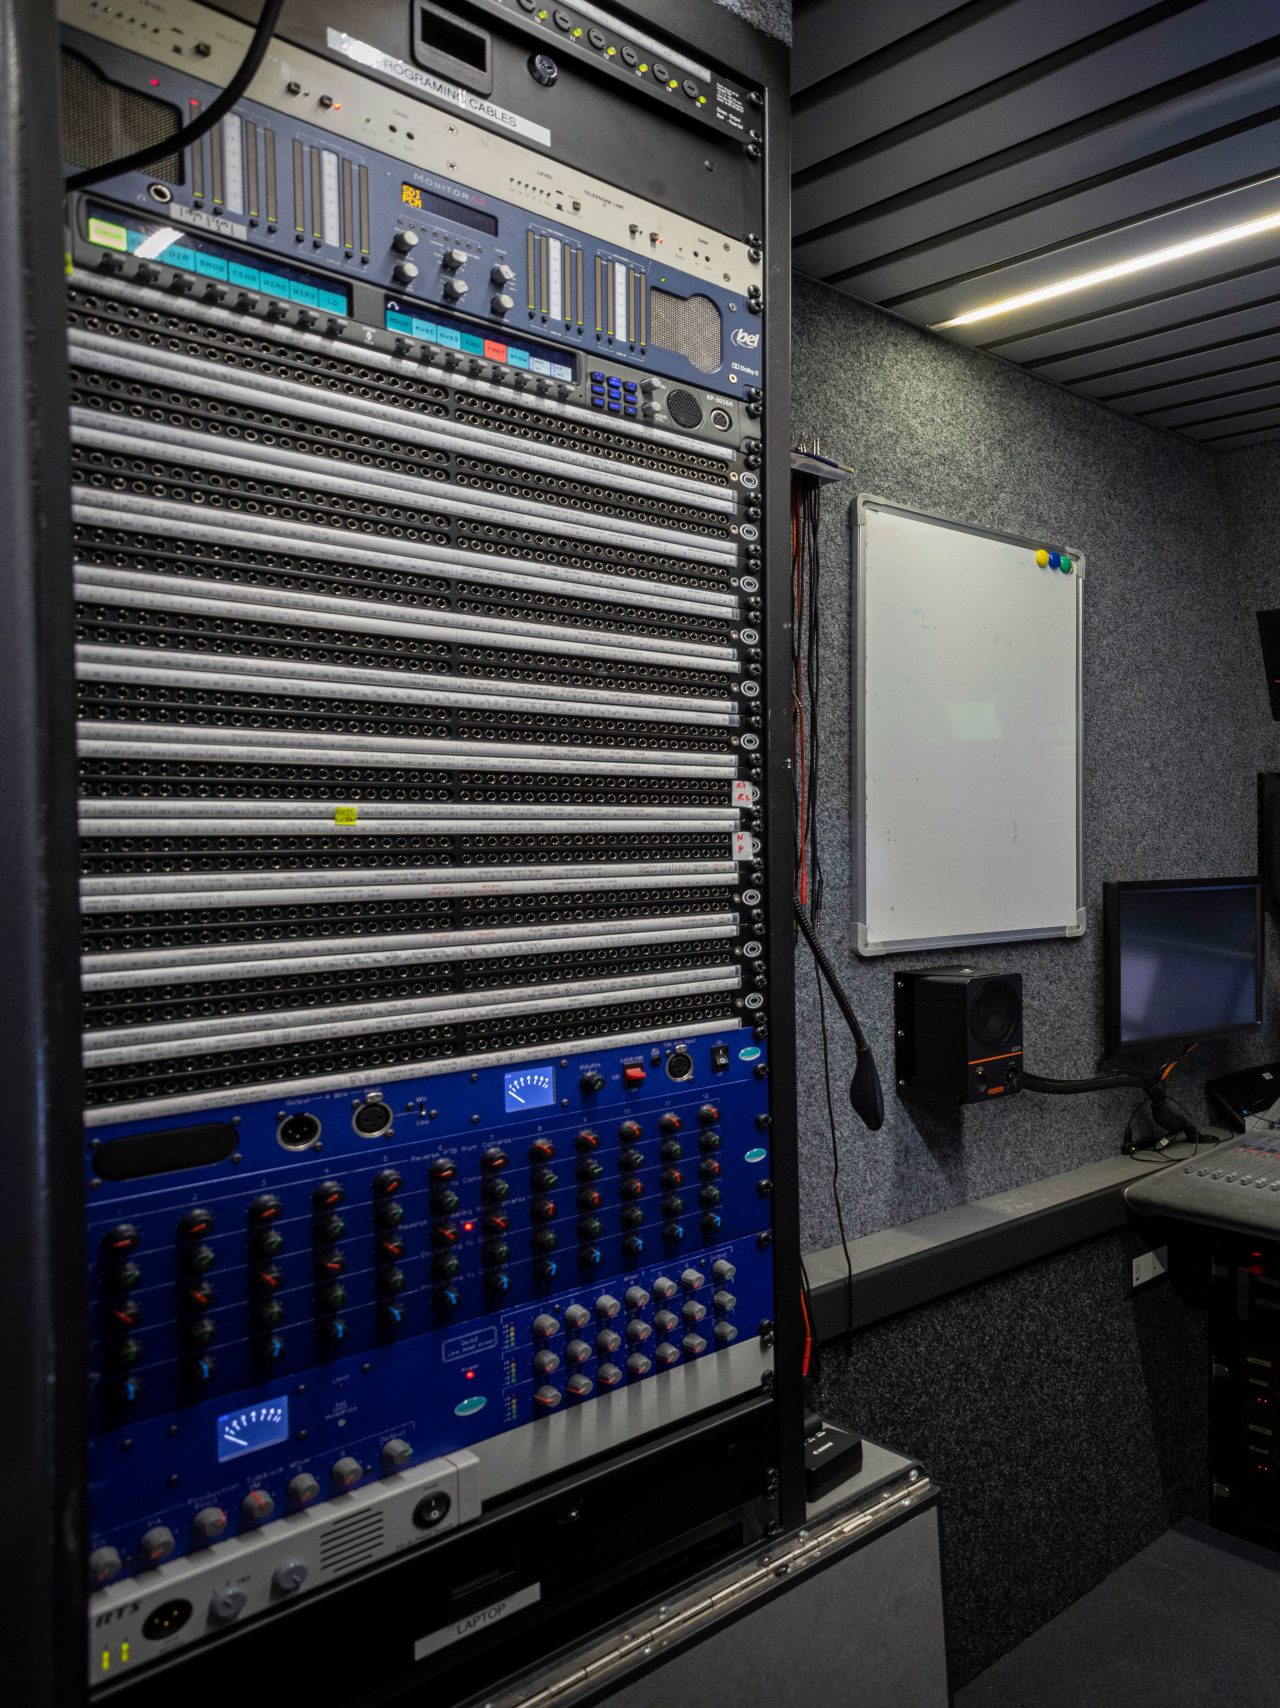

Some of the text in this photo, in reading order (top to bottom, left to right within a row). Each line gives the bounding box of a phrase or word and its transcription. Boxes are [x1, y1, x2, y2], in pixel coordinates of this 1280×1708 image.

[469, 98, 517, 128] CABLES
[413, 172, 469, 199] MONITOR
[537, 170, 553, 180] LEVEL
[402, 185, 421, 199] SDI
[410, 1152, 440, 1161] Reverse
[462, 1144, 478, 1152] from
[482, 1137, 512, 1148] Cameras
[187, 1483, 240, 1507] Production
[456, 1603, 507, 1634] LAPTOP
